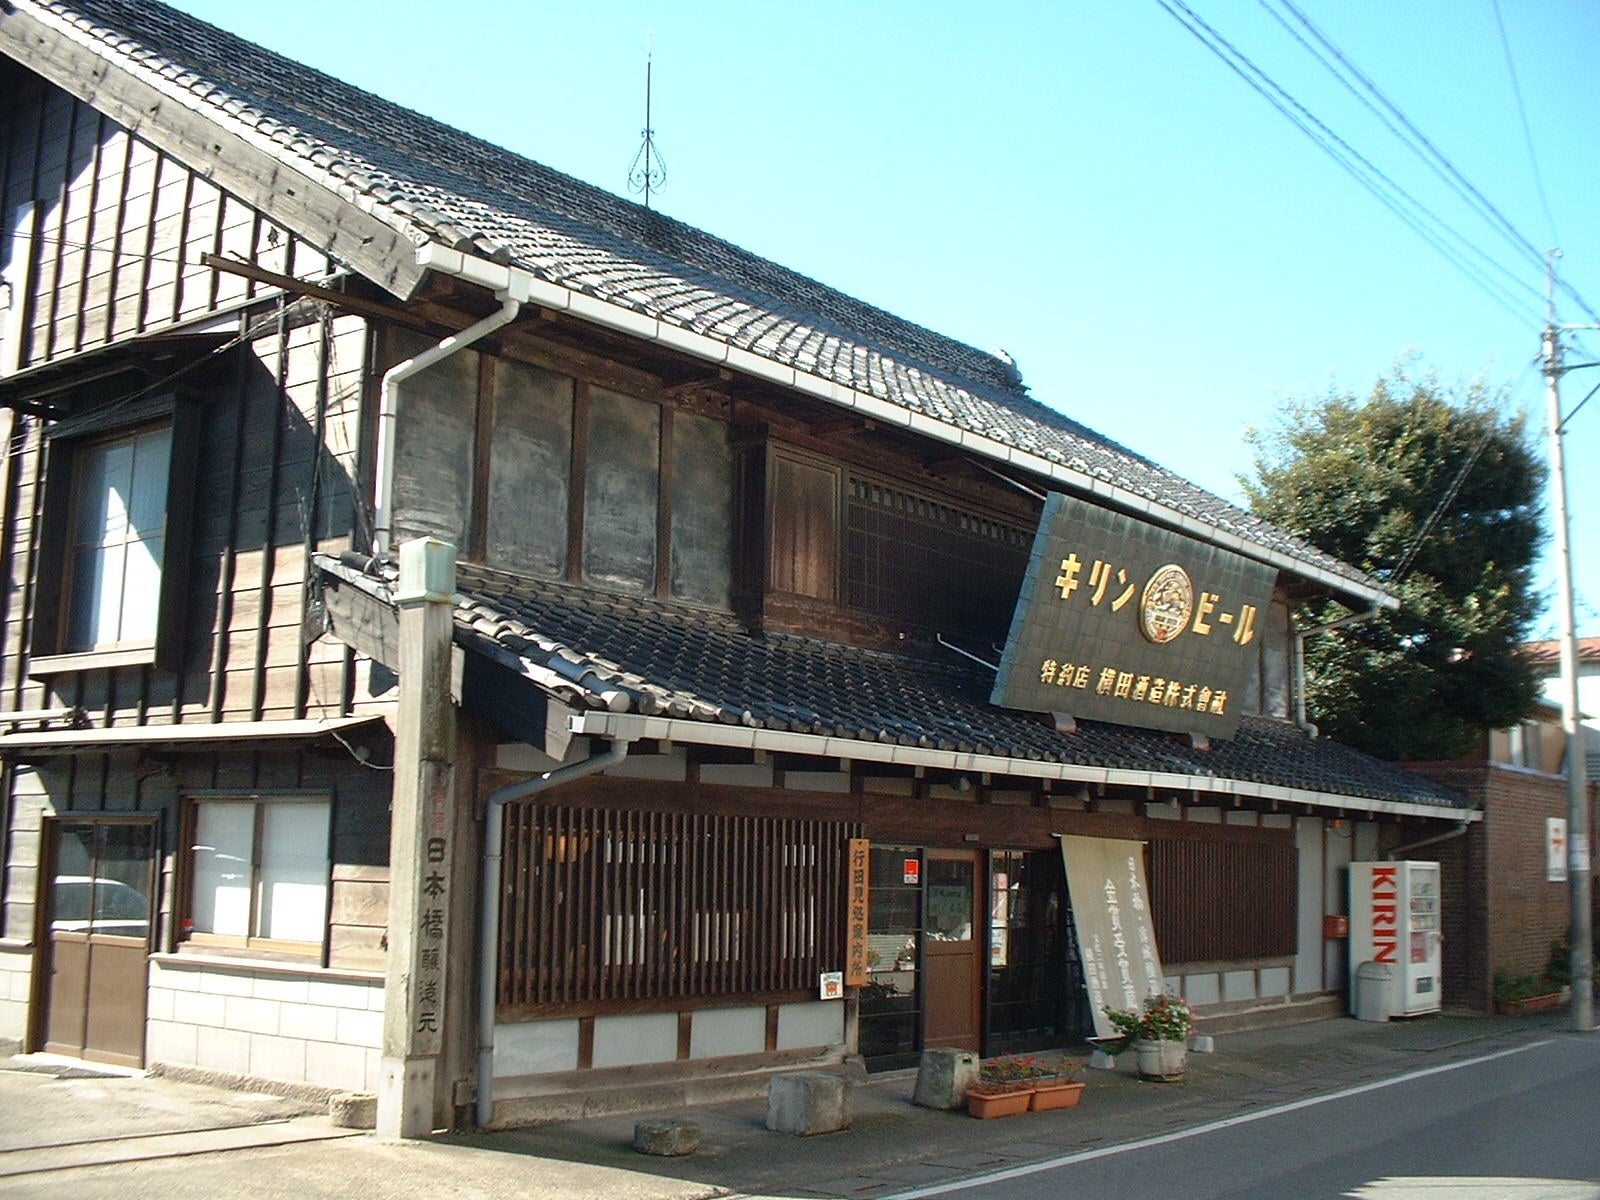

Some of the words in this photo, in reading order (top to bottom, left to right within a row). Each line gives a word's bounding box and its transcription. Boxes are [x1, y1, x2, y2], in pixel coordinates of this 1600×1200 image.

[1055, 553, 1136, 612] キリン
[1192, 592, 1256, 645] ビール
[1041, 658, 1091, 689] 特約店
[1372, 867, 1397, 964] KIRIN
